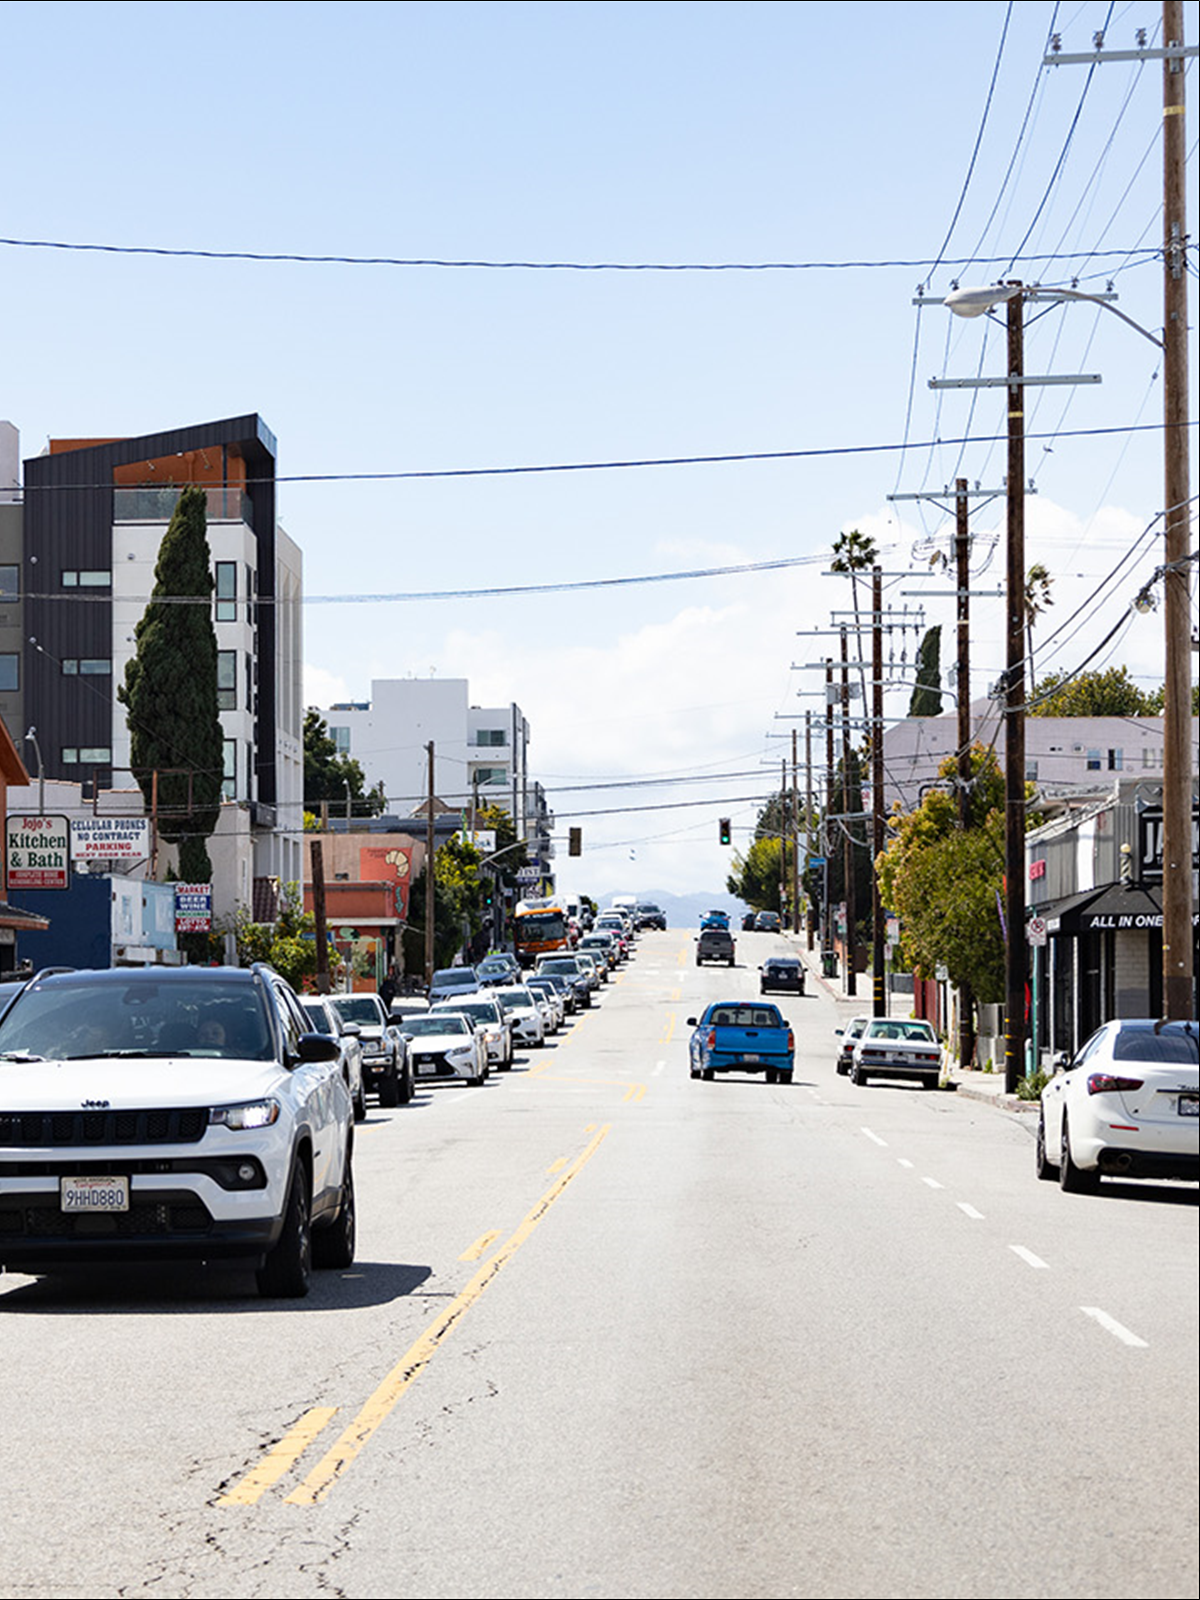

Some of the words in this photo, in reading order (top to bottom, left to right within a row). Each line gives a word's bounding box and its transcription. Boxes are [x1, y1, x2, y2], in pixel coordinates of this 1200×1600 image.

[22, 817, 53, 832] Jojo's
[71, 819, 112, 831] CELLULAR
[114, 819, 146, 831] PHONES
[9, 833, 66, 849] Kitchen
[77, 832, 90, 841] NO
[92, 831, 141, 841] CONTRACT
[85, 842, 132, 851] PARKING
[10, 852, 22, 868] &
[28, 852, 64, 868] Bath
[177, 886, 210, 894] MARKET
[1090, 915, 1116, 928] ALL
[1118, 915, 1134, 927] IN
[1135, 915, 1163, 927] ONE
[81, 1099, 110, 1108] Jeep
[66, 1189, 125, 1206] 9HHD880
